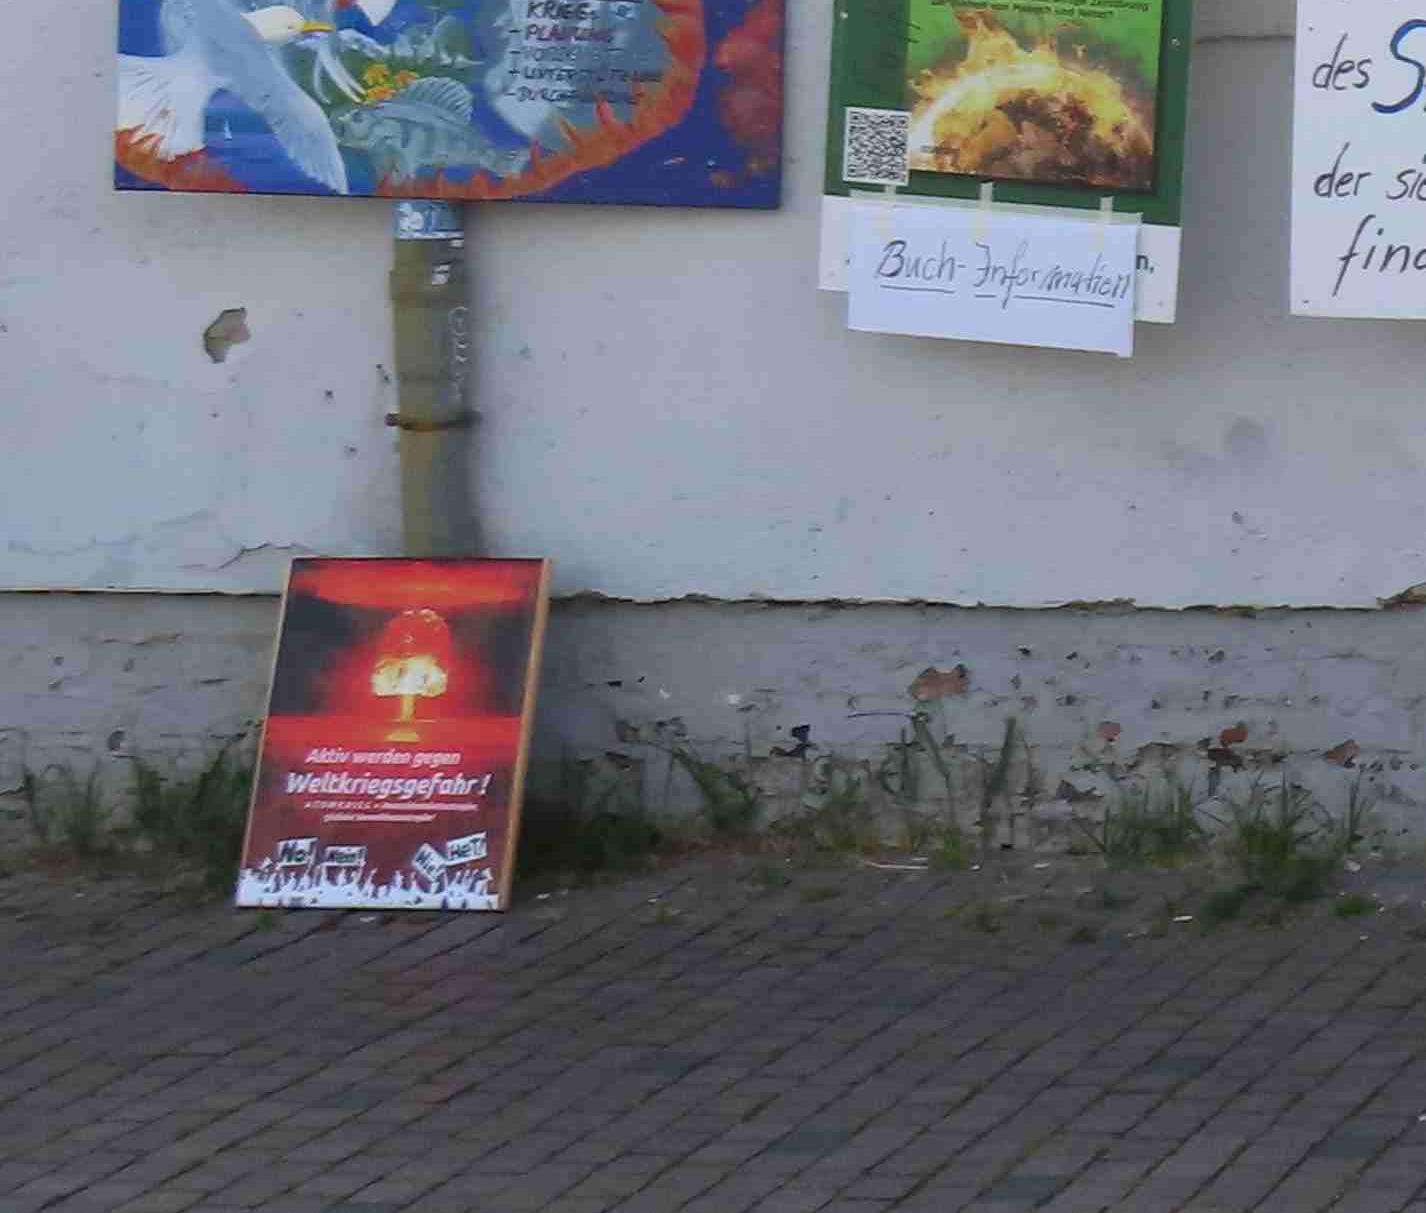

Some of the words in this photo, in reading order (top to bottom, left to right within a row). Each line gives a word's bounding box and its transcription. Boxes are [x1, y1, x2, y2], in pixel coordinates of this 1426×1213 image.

[1312, 32, 1372, 90] des
[1313, 141, 1372, 199] der
[304, 747, 350, 765] Aktiv
[352, 748, 411, 765] werden
[411, 752, 461, 769] gegen
